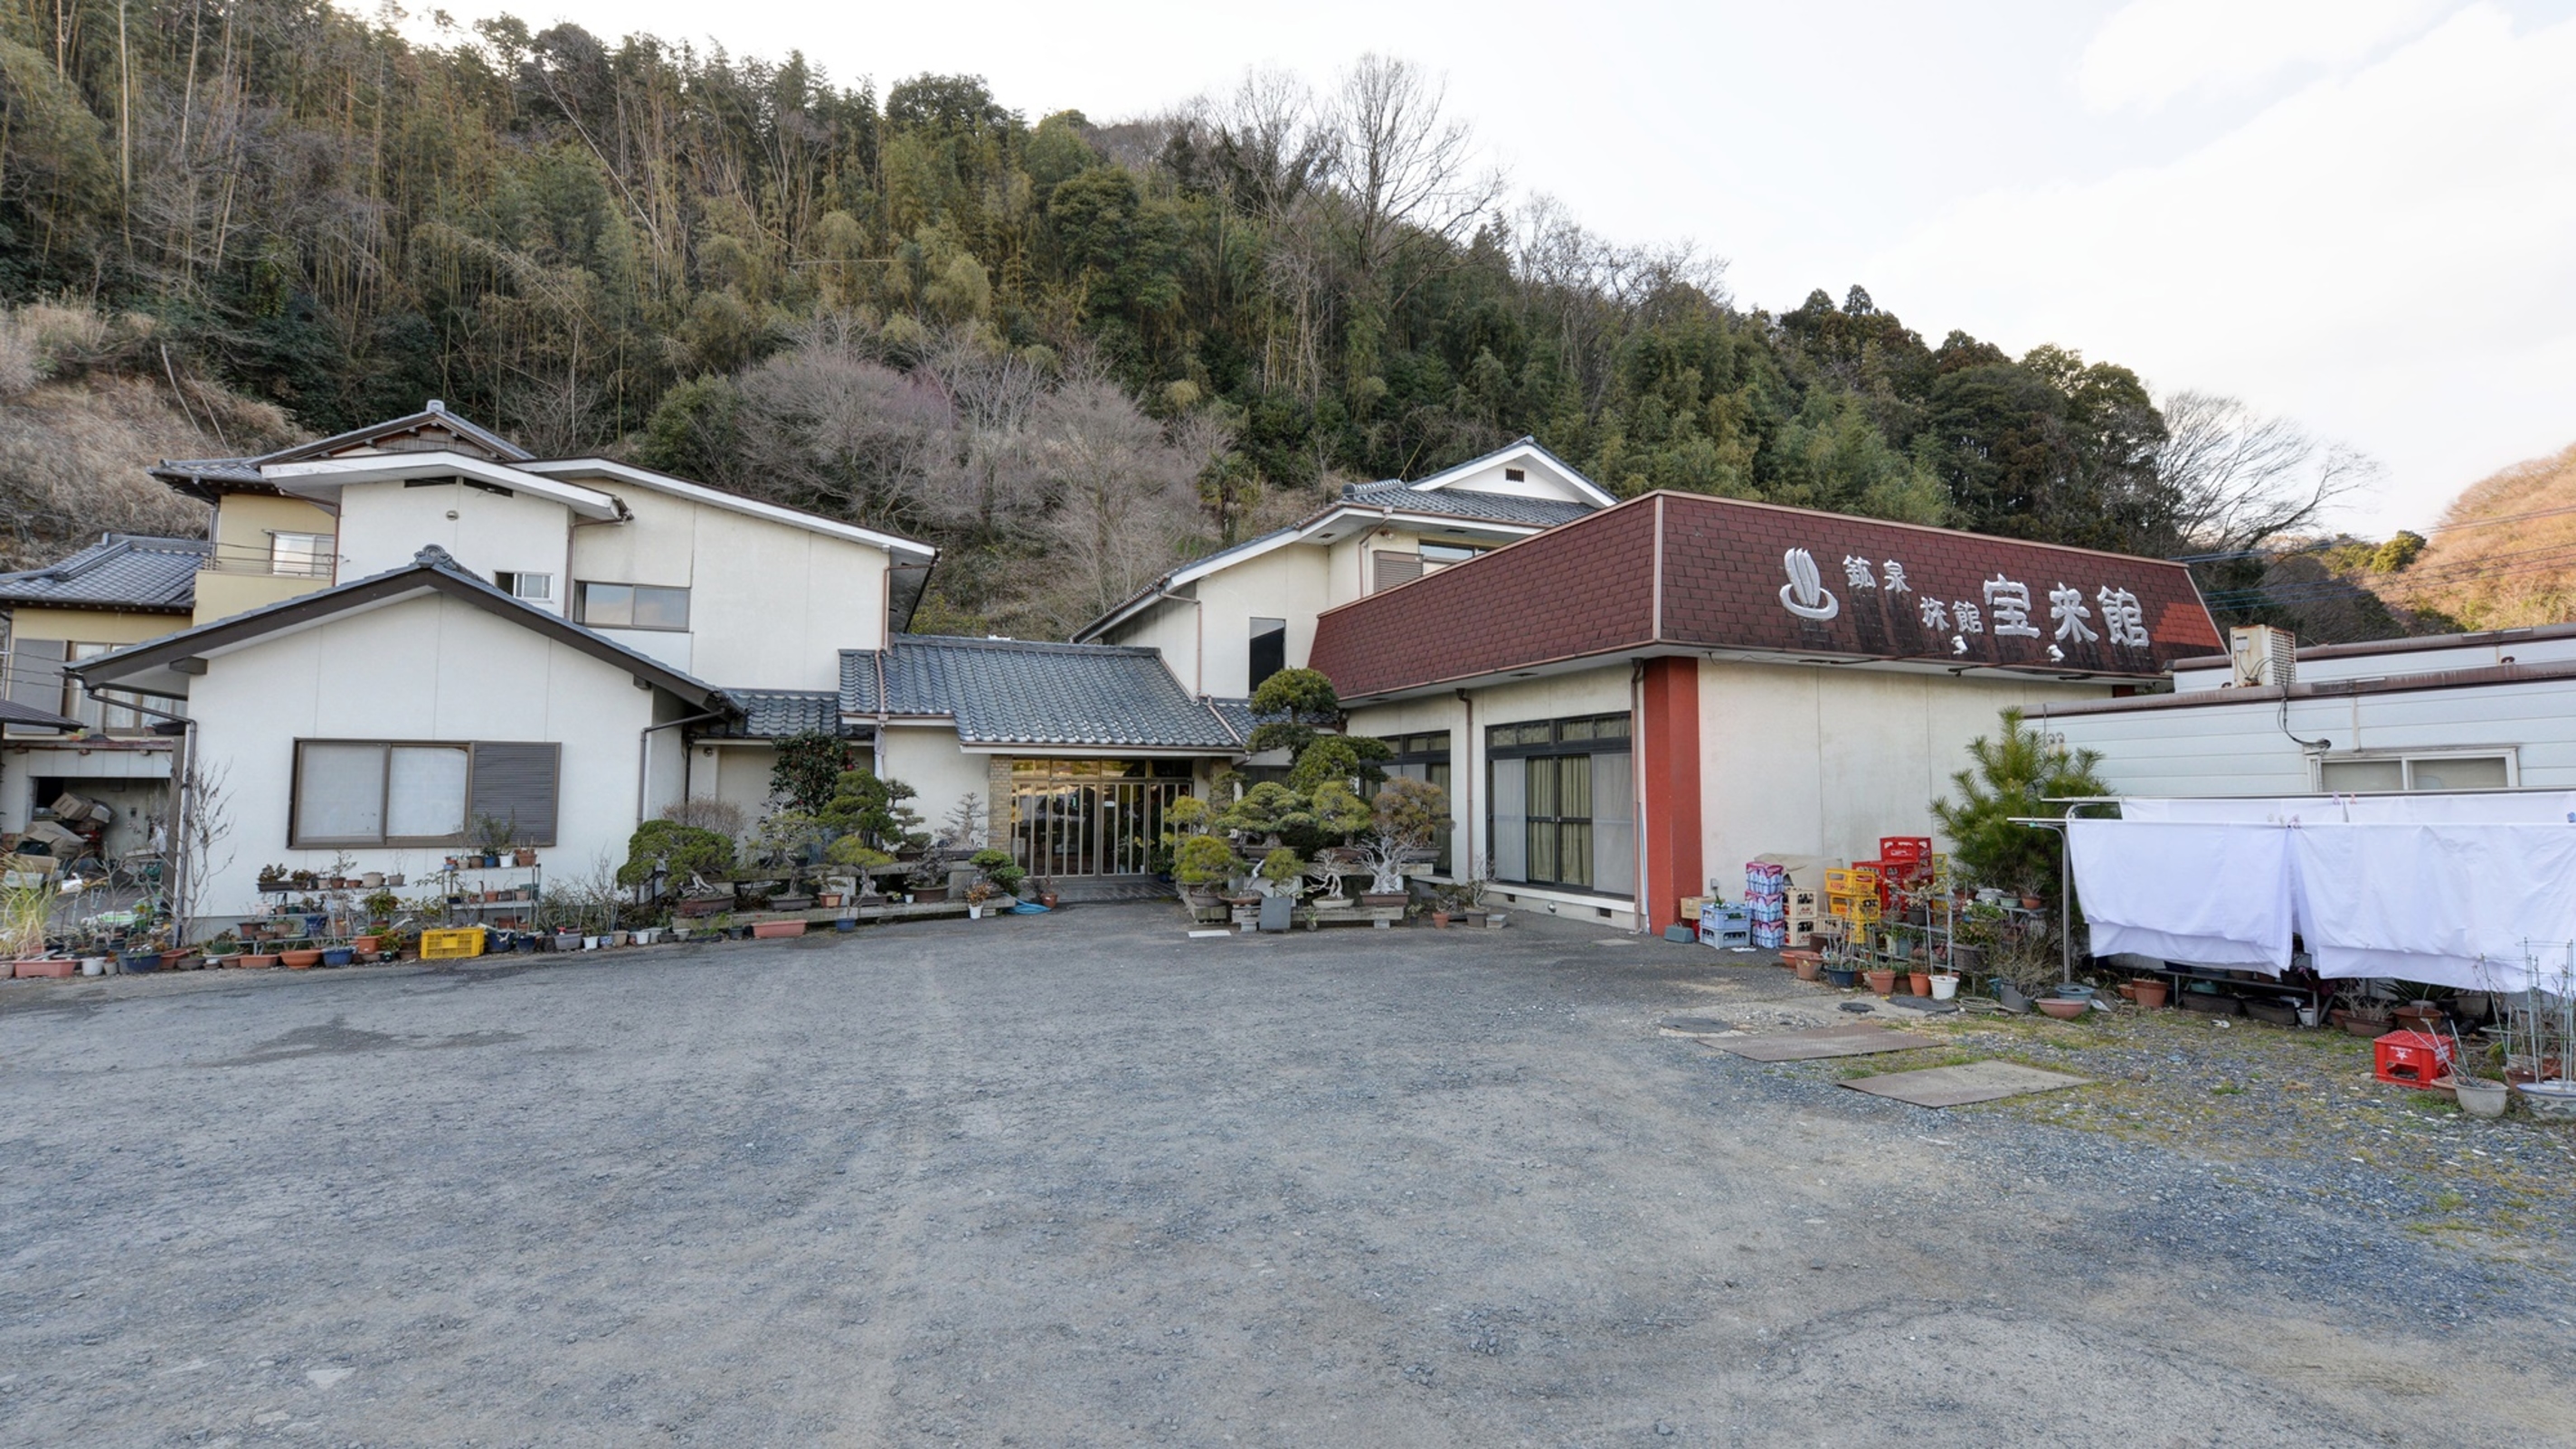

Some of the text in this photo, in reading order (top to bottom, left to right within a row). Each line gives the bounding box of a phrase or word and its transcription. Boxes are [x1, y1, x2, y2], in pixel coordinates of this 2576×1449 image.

[1842, 554, 1912, 592] 鉱泉
[1919, 573, 2150, 648] 旅館 宝来館
